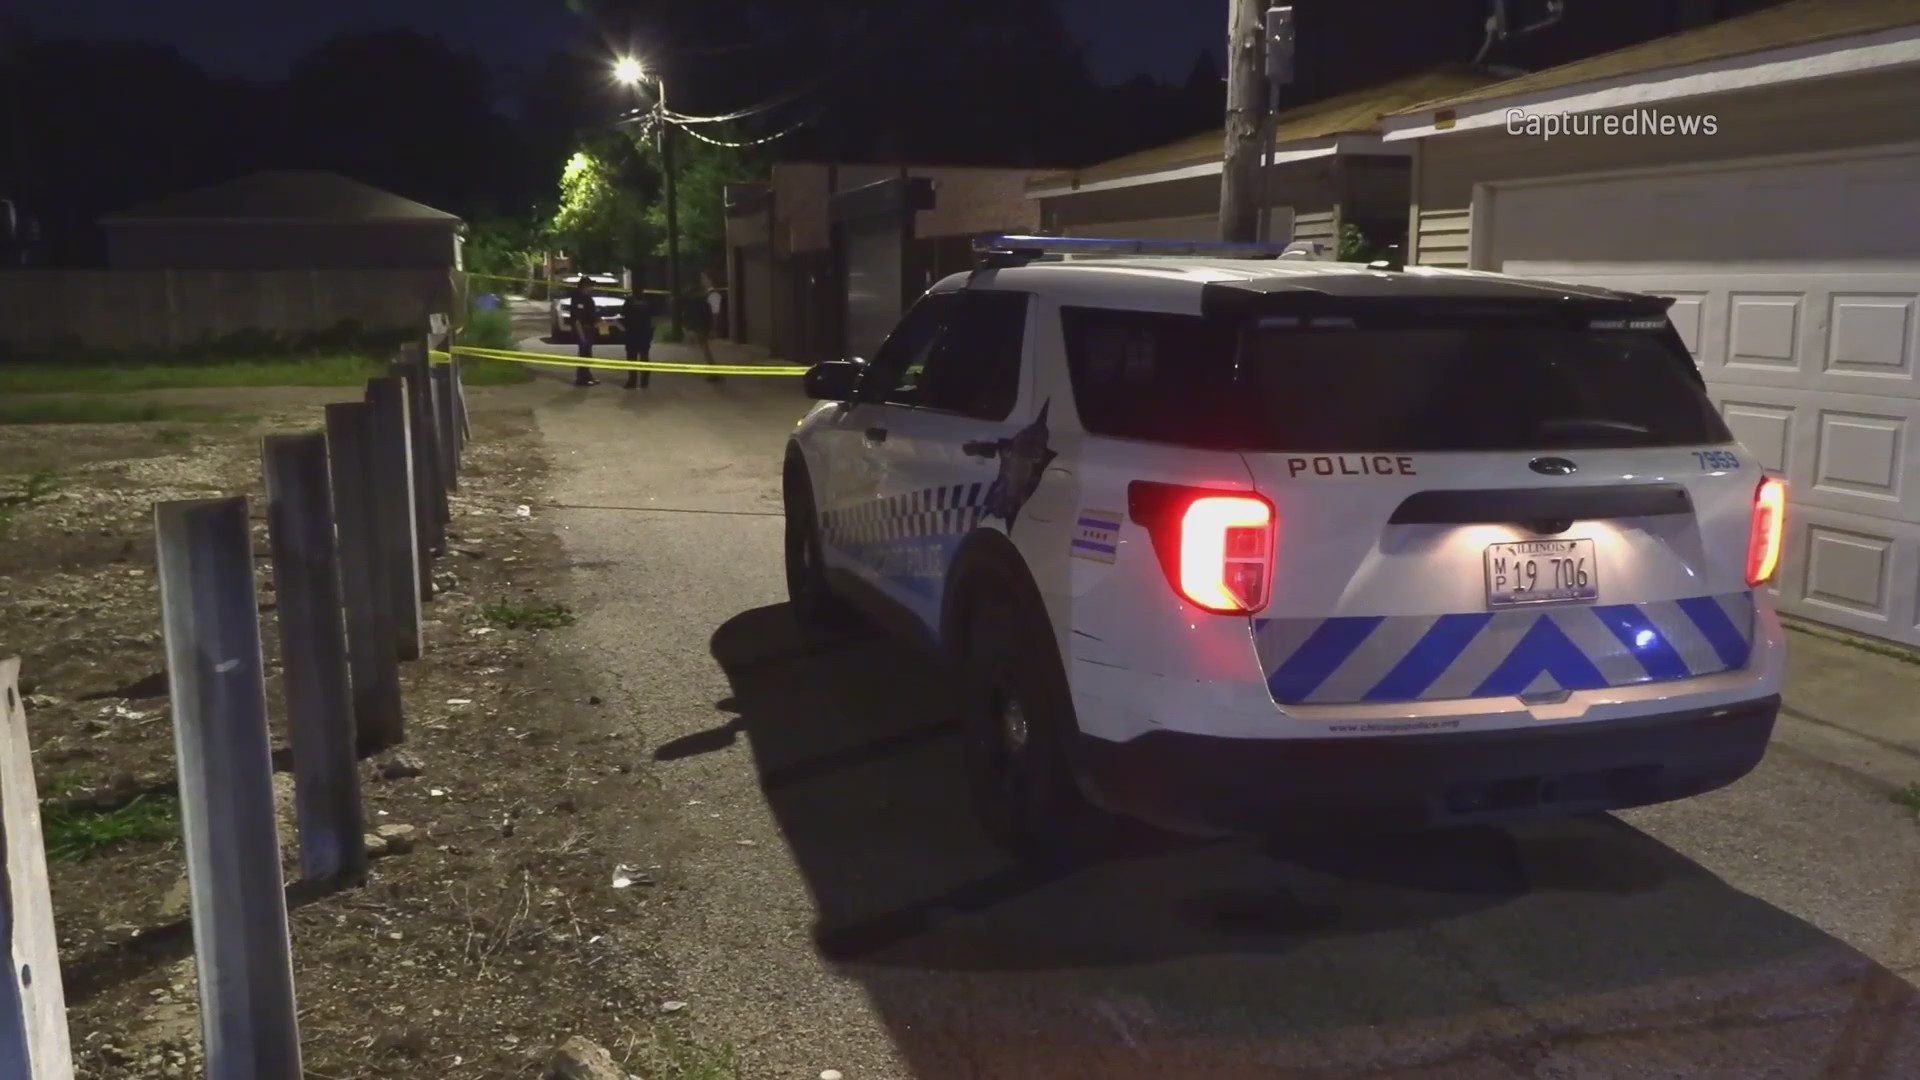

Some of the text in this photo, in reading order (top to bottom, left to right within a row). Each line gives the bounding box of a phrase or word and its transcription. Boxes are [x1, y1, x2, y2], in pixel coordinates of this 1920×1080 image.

[1287, 456, 1417, 478] POLICE
[1691, 451, 1740, 470] 7959
[1517, 543, 1565, 554] ILLINOIS
[1513, 560, 1537, 592] 19
[1551, 557, 1588, 589] 706
